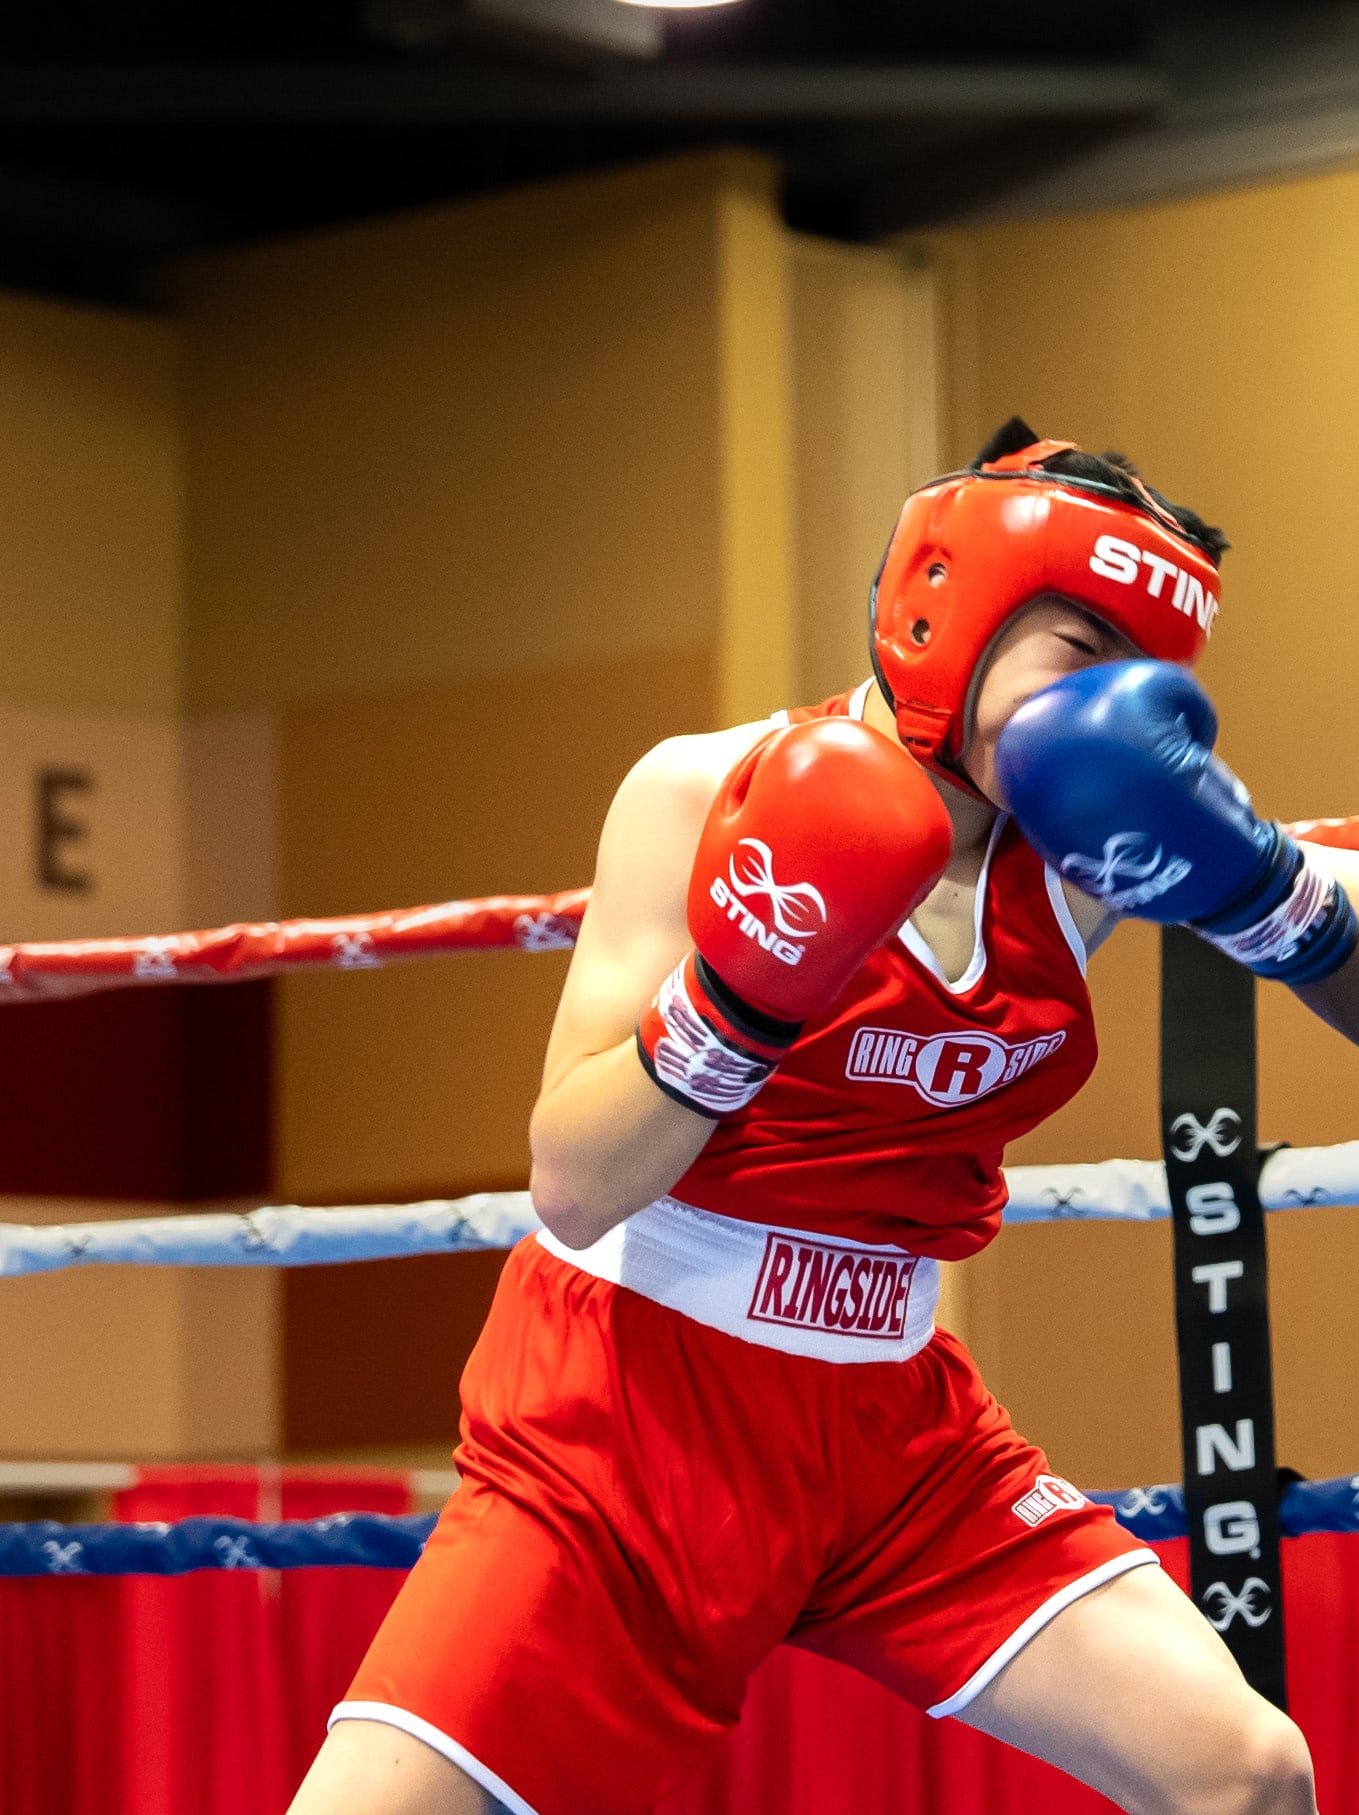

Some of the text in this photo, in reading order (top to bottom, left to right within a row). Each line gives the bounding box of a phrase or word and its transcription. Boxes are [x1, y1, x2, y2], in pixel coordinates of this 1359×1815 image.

[1089, 534, 1219, 640] STIN
[36, 769, 93, 893] E
[709, 876, 803, 967] STING
[853, 1033, 917, 1077] RING
[930, 1040, 992, 1095] R
[759, 1242, 914, 1332] RINGSIDE
[1185, 1181, 1260, 1556] STING
